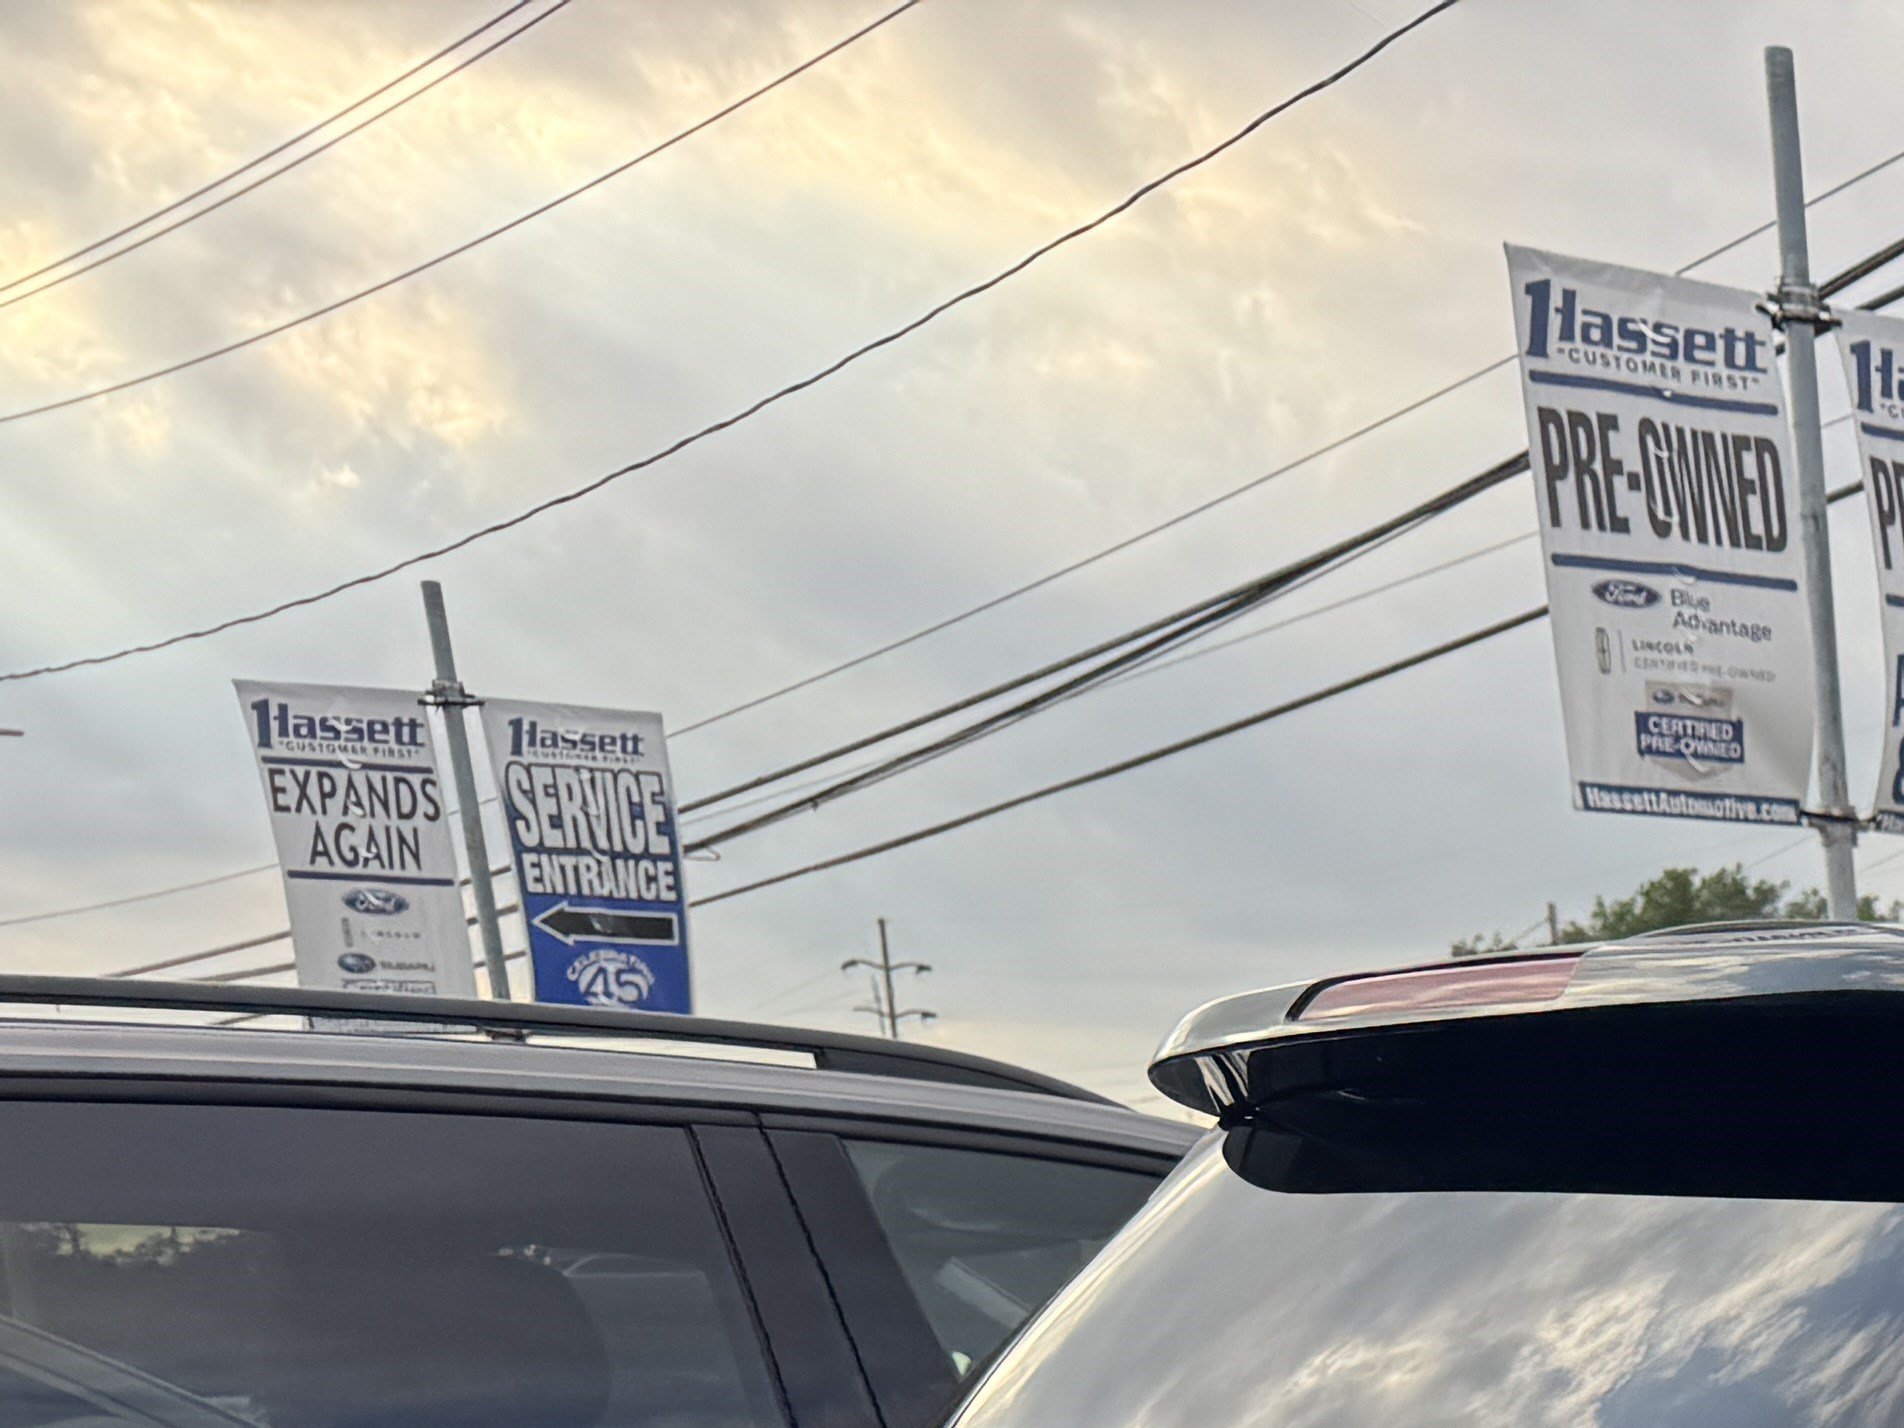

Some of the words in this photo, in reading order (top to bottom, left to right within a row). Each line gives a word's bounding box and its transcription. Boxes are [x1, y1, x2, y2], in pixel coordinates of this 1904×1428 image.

[1537, 405, 1788, 553] PRE-OWNED
[1631, 638, 1695, 656] LINCOLN
[1672, 610, 1773, 643] Advantage
[1640, 733, 1742, 759] PRE-OWNED
[1648, 716, 1734, 740] CERTIFIED
[268, 768, 441, 823] EXPANDS
[505, 761, 672, 855] SERVICE
[309, 821, 422, 871] AGAIN
[521, 851, 679, 902] ENTRANCE
